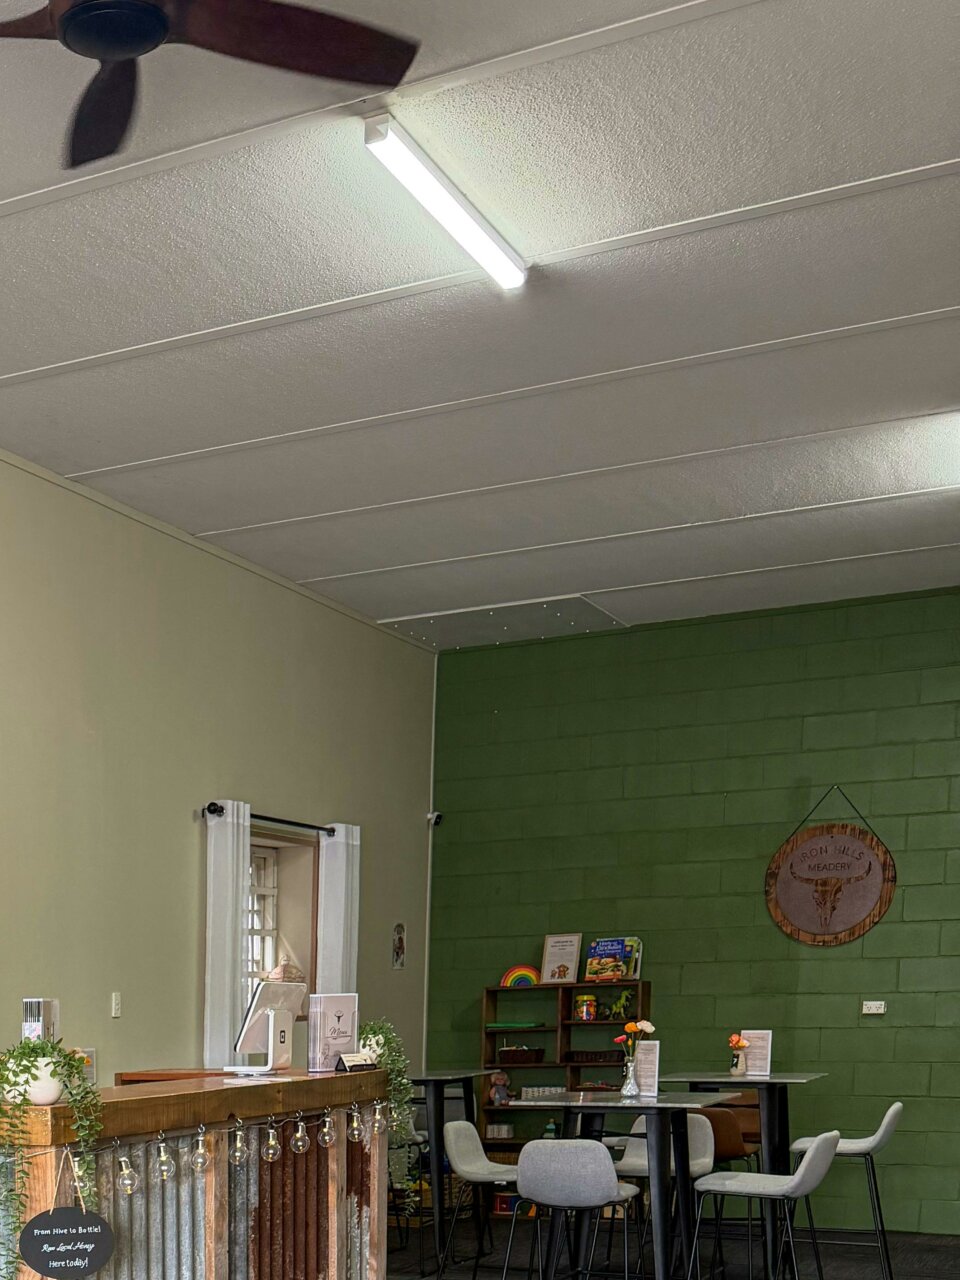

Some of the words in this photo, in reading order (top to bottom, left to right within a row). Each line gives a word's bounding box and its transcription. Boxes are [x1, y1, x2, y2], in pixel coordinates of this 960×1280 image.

[800, 846, 828, 863] IRON
[834, 845, 864, 861] HILLS
[808, 862, 852, 872] MEADERY
[78, 1225, 101, 1234] Bottle!
[41, 1243, 55, 1252] Raw
[56, 1242, 73, 1252] Local
[73, 1241, 95, 1252] Honey
[49, 1260, 65, 1268] Here
[66, 1257, 88, 1268] today!
